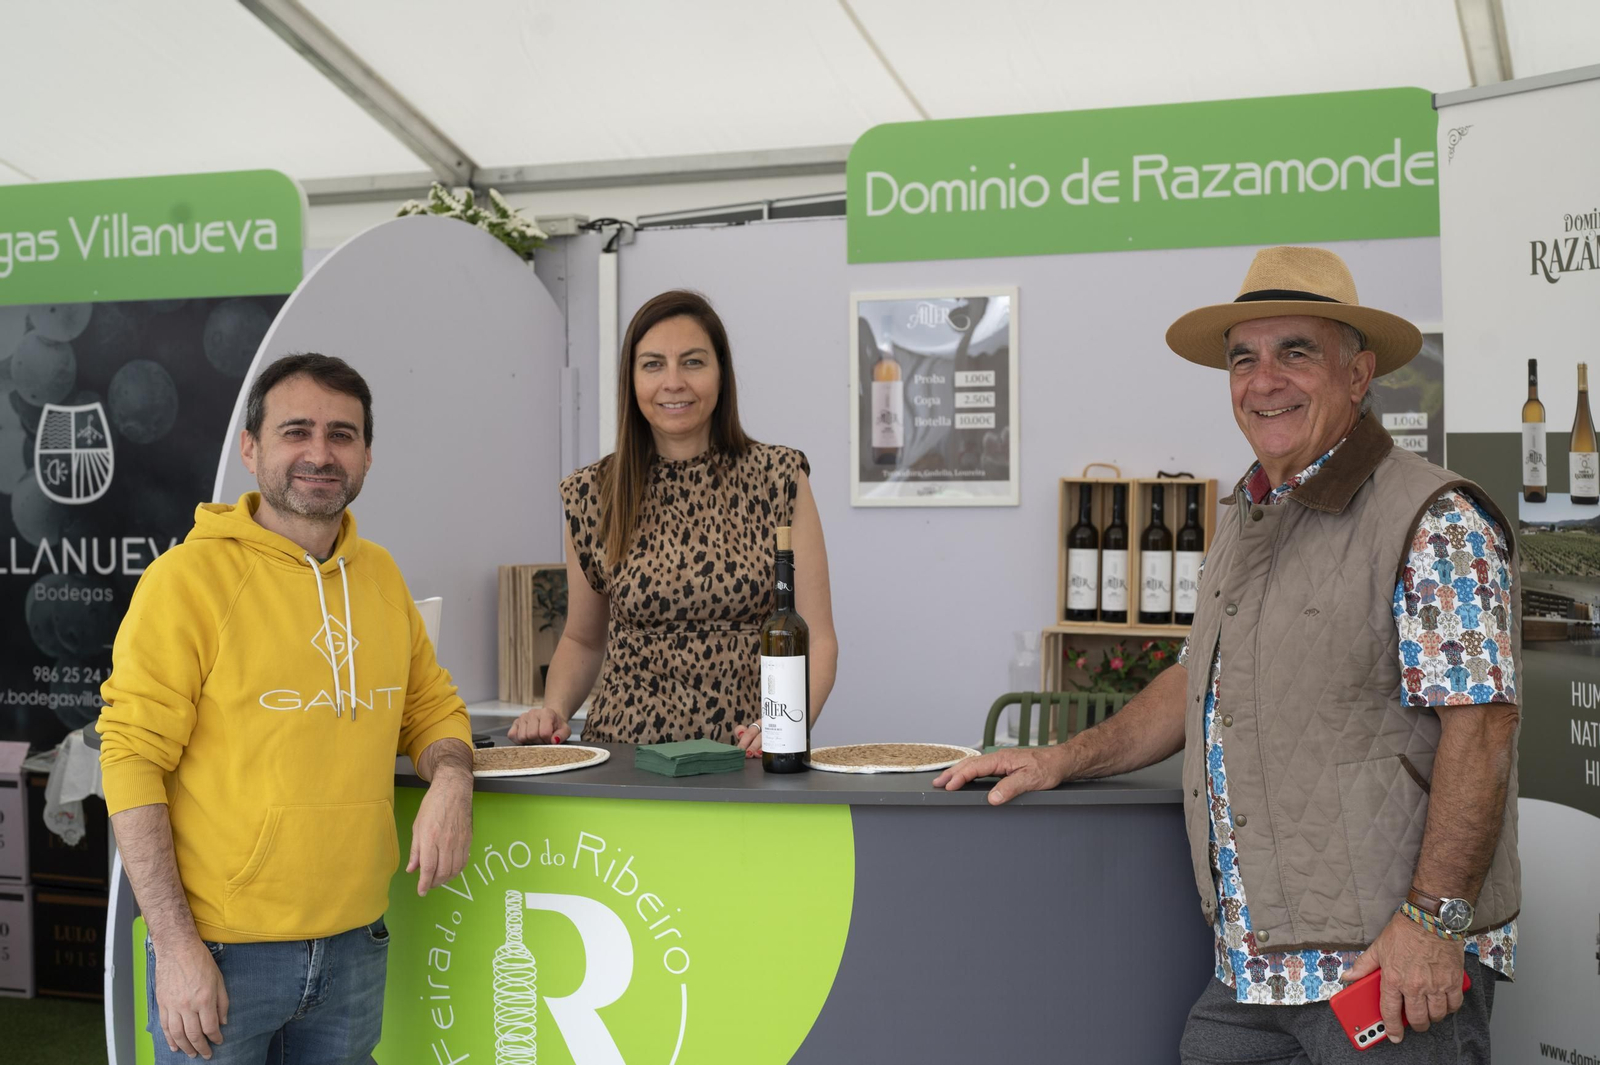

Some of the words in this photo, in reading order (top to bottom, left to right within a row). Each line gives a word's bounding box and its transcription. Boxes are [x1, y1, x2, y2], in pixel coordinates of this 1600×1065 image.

[866, 163, 1050, 217] Dominio
[1061, 157, 1120, 206] de
[1133, 138, 1436, 202] Razamonde
[1563, 208, 1600, 232] DOMI
[68, 212, 278, 261] Villanueva
[914, 373, 946, 384] Proba
[965, 374, 992, 384] 1.00€
[914, 395, 941, 408] Copa
[964, 394, 992, 404] 2.50€
[959, 415, 992, 425] 10.00€
[1394, 416, 1424, 426] 1.00€
[34, 582, 113, 605] Bodegas
[33, 665, 59, 682] 986
[62, 667, 80, 683] 25
[83, 667, 101, 684] 24
[259, 687, 402, 711] GANT
[540, 838, 565, 866] do
[573, 831, 690, 975] Ribeiro
[435, 910, 463, 942] do
[420, 946, 470, 1065] Feira
